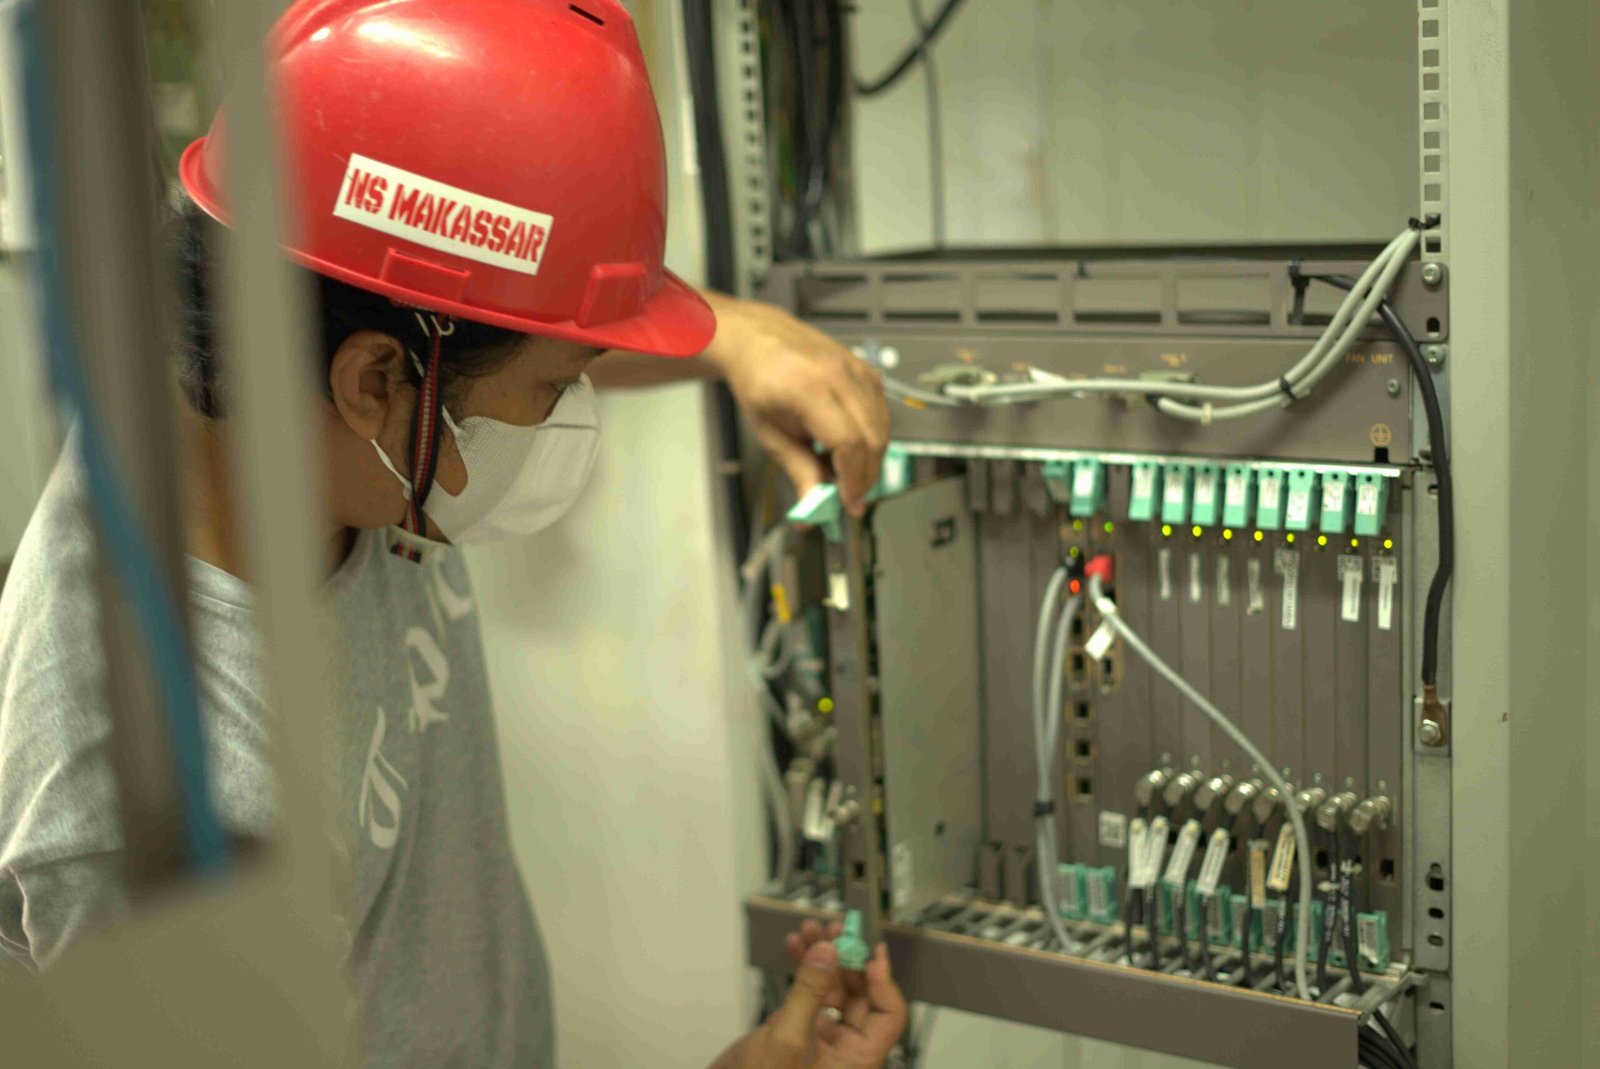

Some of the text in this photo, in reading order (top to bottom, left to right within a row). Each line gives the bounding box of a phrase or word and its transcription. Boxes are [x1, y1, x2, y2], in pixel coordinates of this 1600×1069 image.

[344, 168, 546, 263] NS MAKASSAR
[1371, 353, 1393, 364] UNIT
